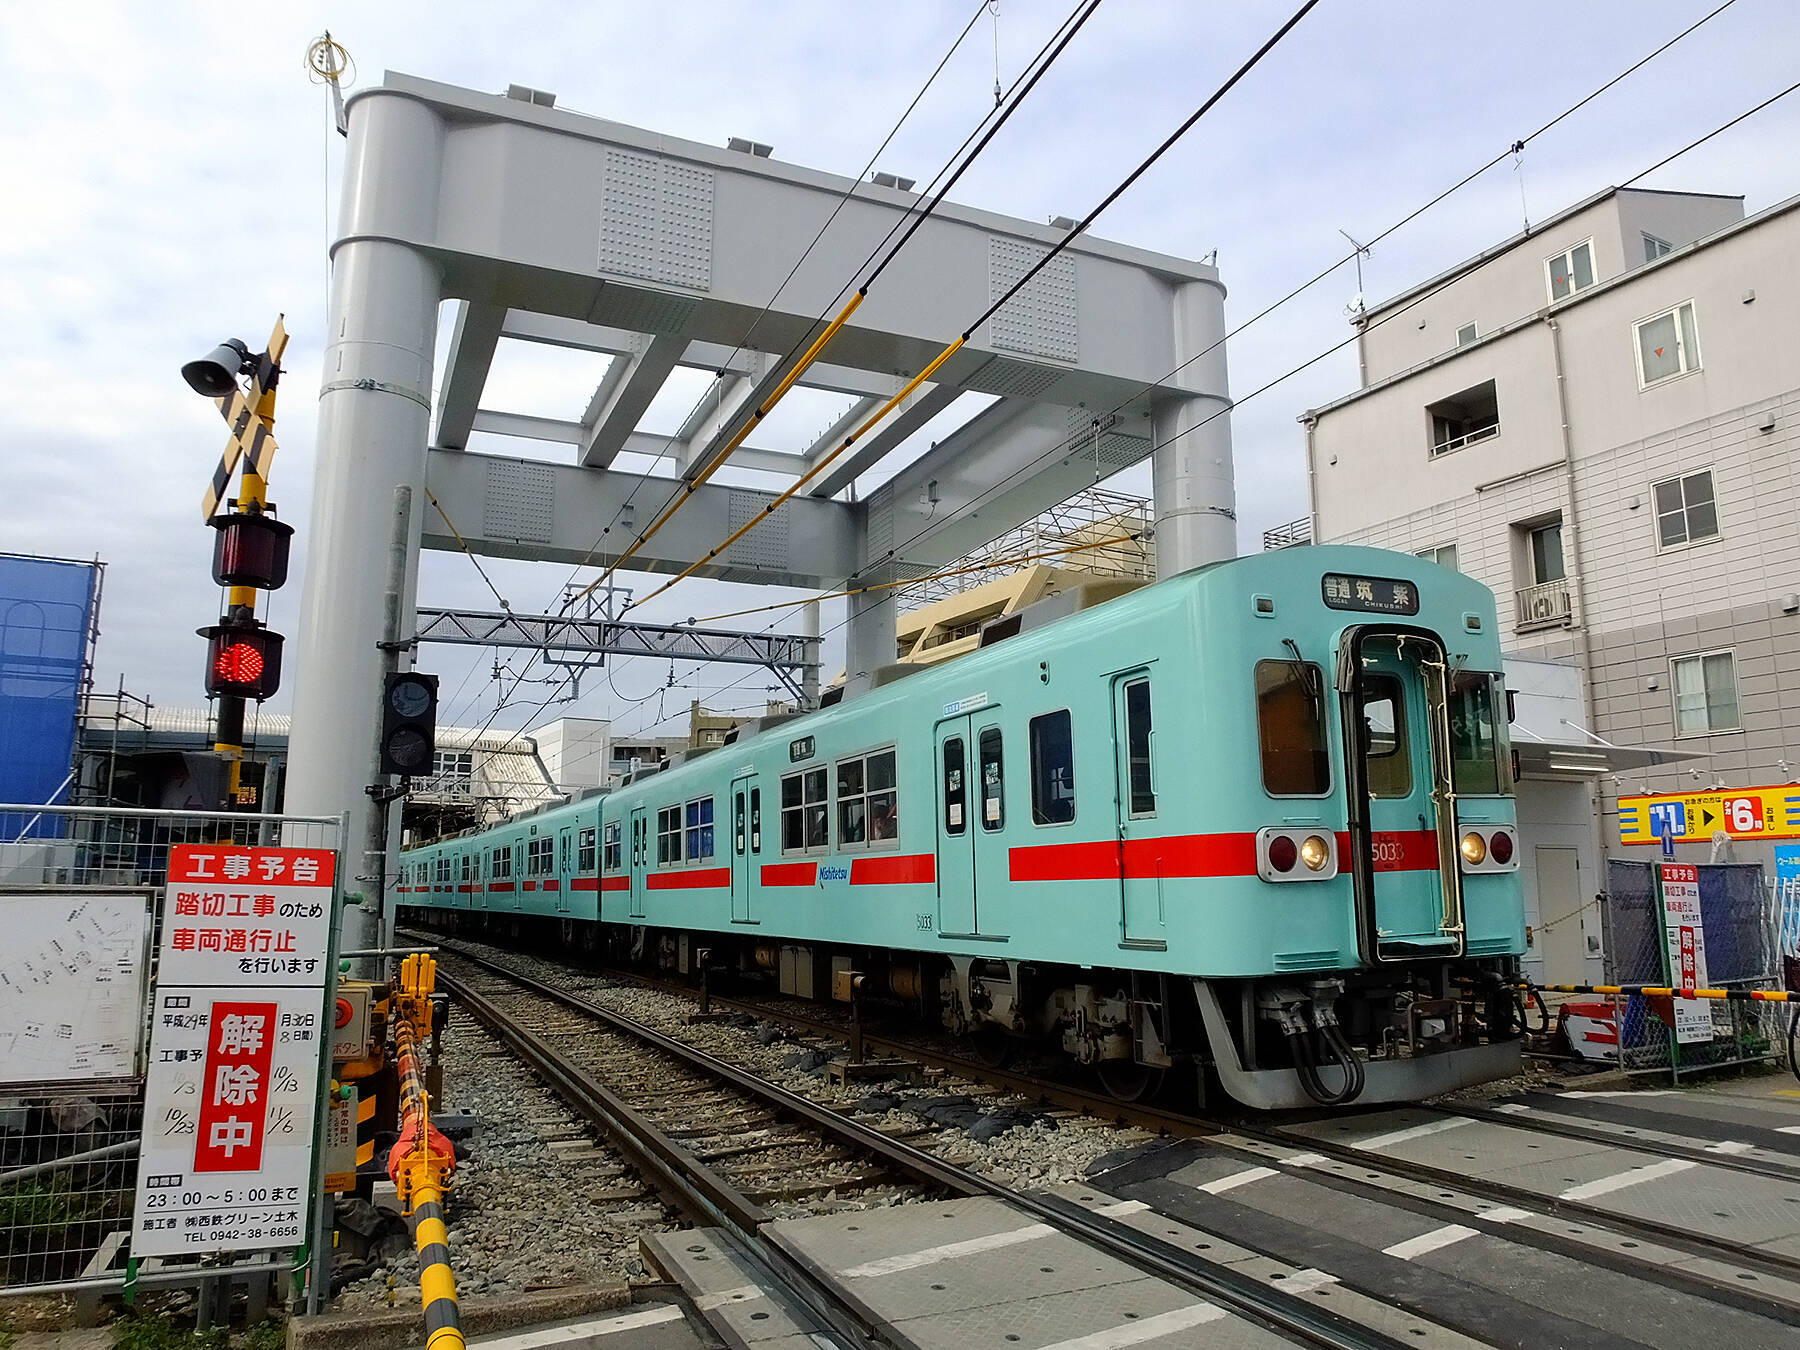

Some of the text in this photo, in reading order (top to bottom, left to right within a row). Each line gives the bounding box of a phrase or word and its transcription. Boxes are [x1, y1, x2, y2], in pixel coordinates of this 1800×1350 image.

[1325, 577, 1351, 599] 普通
[1356, 580, 1410, 606] 筑紫
[1364, 601, 1403, 610] CHIKUSHI
[1371, 842, 1404, 862] 5033
[185, 853, 320, 882] 工事予告
[819, 866, 848, 880] Nishitetsu
[171, 927, 297, 954] 車両通行止
[238, 957, 319, 975] を行います
[209, 1013, 267, 1158] 解除中
[273, 1065, 299, 1093] 10/13
[164, 1107, 195, 1136] 10/23
[143, 1218, 178, 1231] 施工者
[184, 1226, 299, 1243] TEL 0942-38-6656
